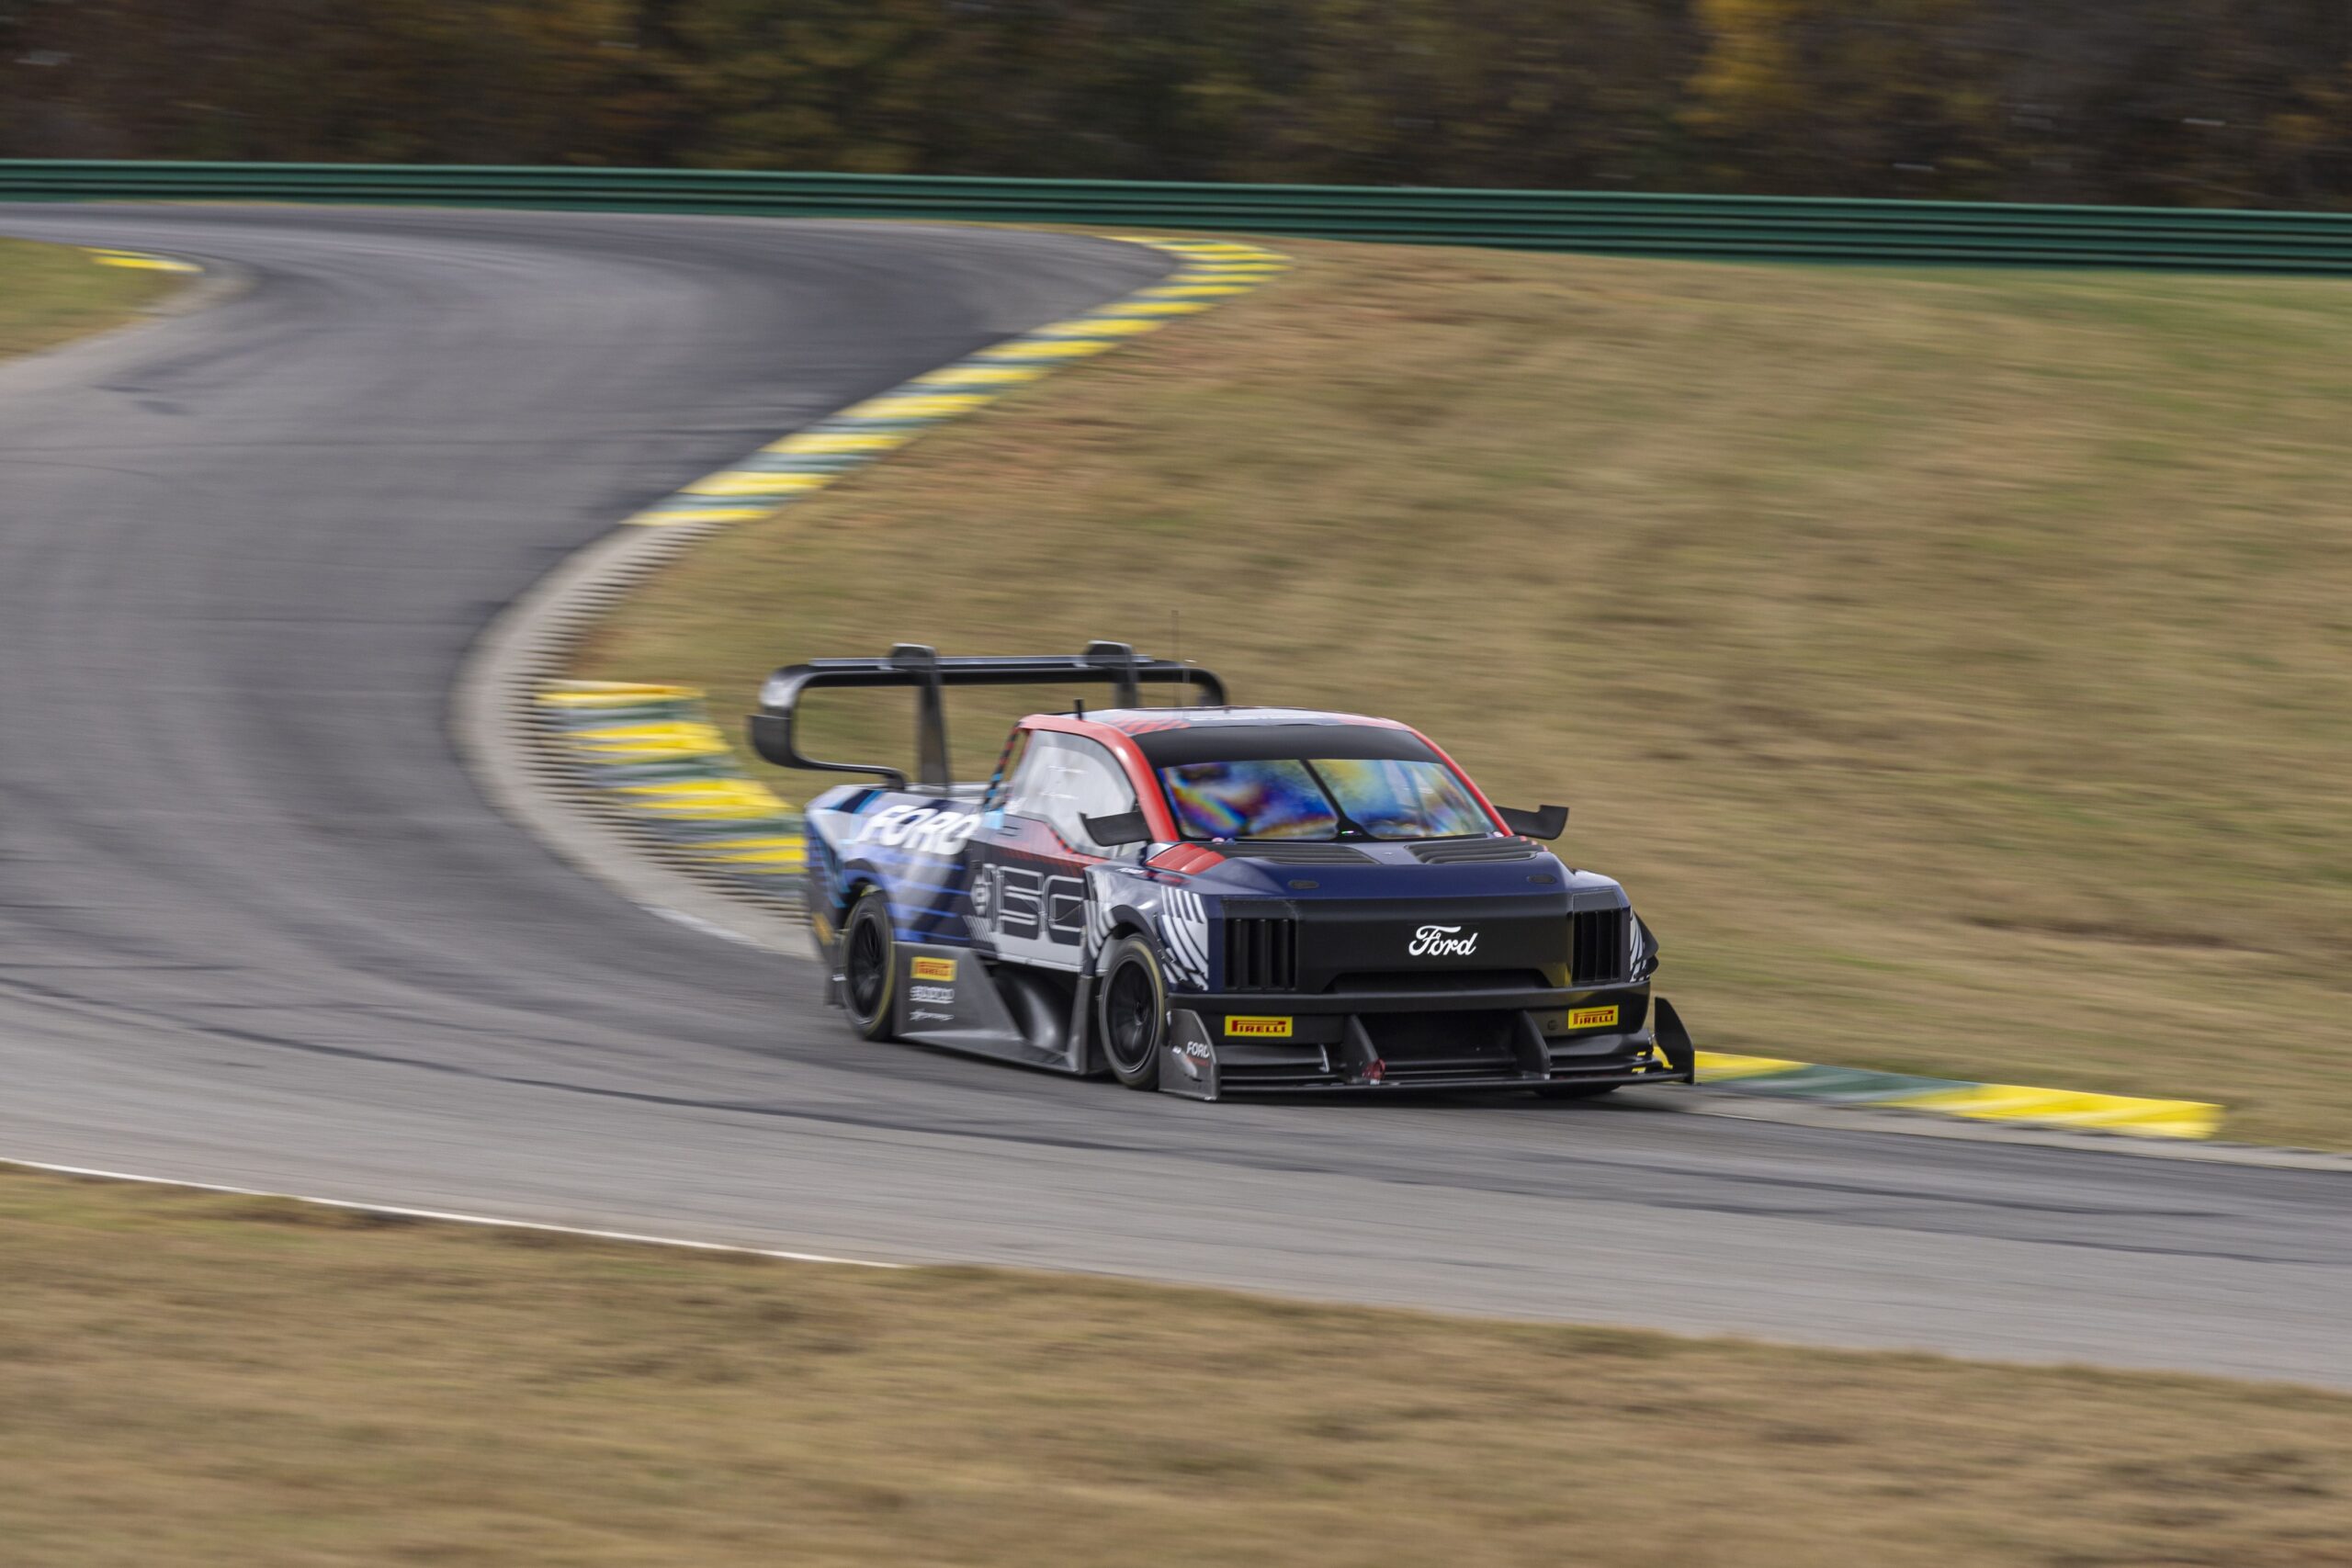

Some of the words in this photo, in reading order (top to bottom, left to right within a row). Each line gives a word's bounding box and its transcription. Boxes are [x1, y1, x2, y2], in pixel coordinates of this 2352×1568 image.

[855, 805, 981, 854] FORD
[1408, 925, 1478, 956] Ford
[1231, 1020, 1286, 1032] PIRELLI
[1573, 1010, 1614, 1025] PIRELLI
